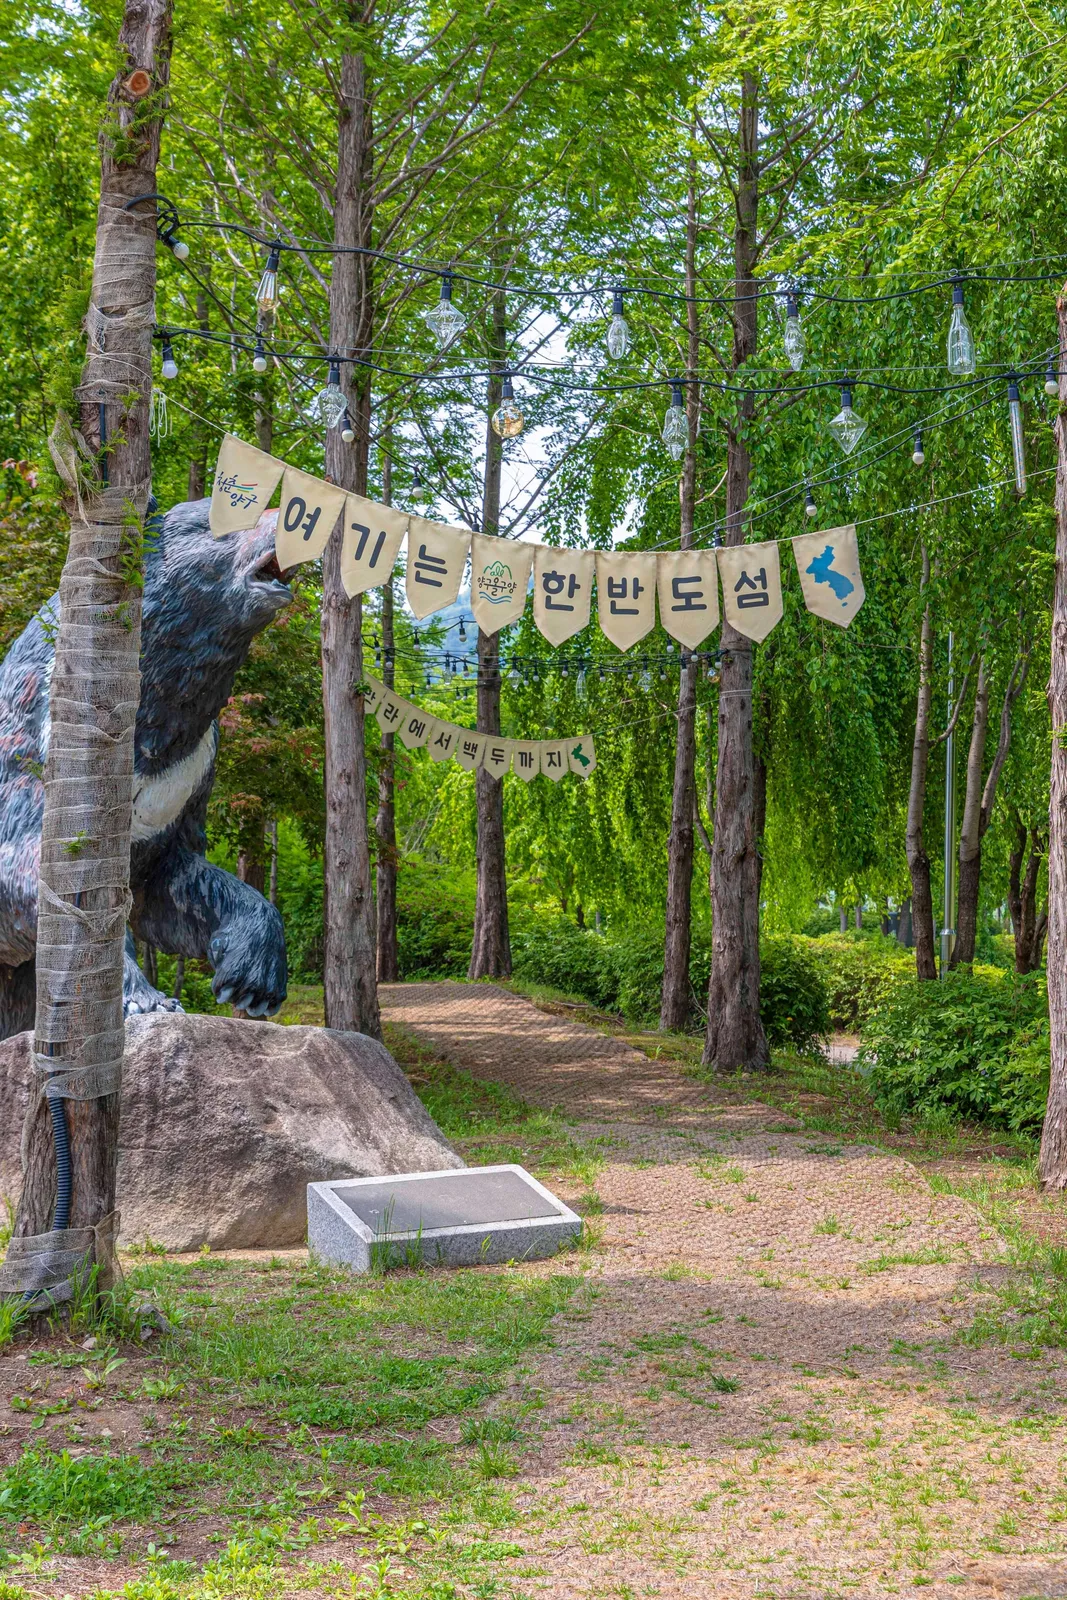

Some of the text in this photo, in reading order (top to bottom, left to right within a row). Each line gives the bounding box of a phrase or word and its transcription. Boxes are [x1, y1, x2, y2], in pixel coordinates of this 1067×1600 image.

[216, 471, 239, 493] 청춘
[230, 493, 259, 509] 양구
[284, 497, 771, 615] 여기는 한반도섬
